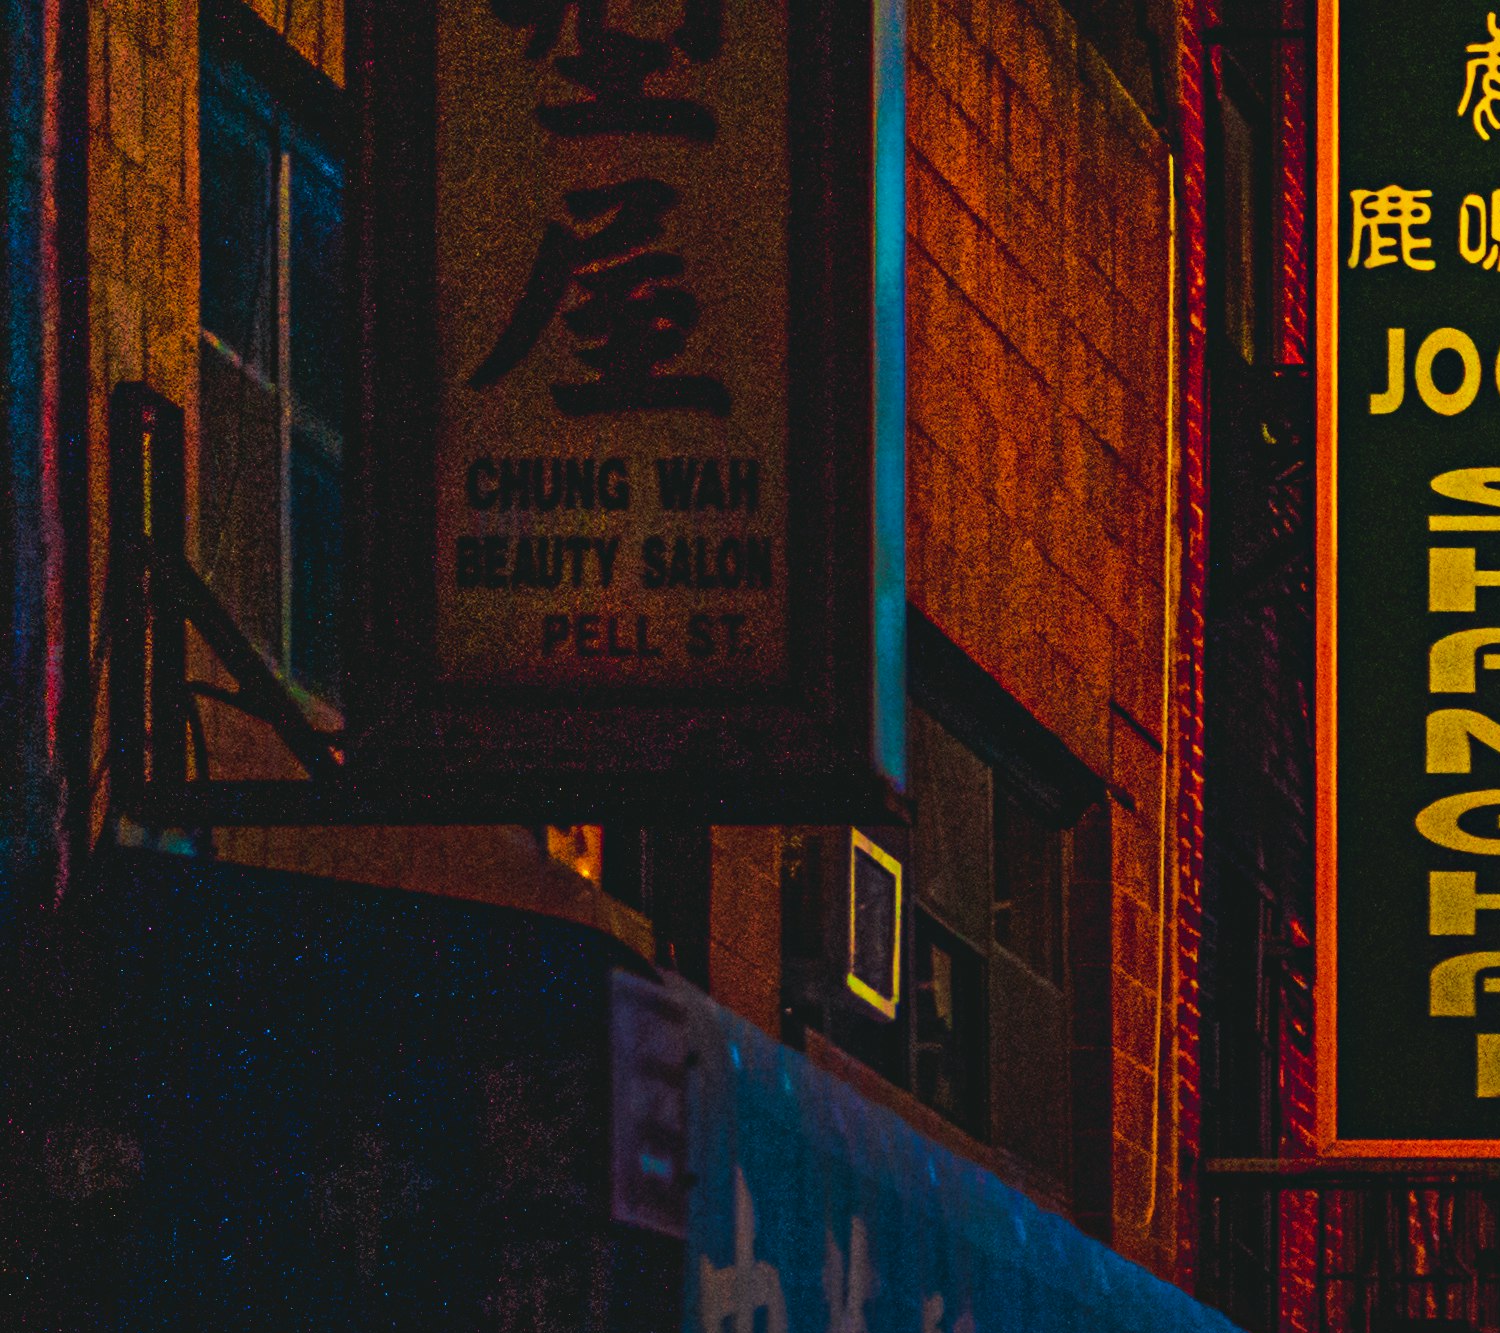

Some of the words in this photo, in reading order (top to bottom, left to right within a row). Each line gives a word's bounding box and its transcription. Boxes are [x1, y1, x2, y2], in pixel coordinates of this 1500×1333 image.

[466, 457, 630, 511] CHUNG
[656, 457, 759, 507] WAH
[457, 537, 618, 590] BEAUTY
[642, 537, 772, 589] SALON
[542, 614, 661, 657] PELL
